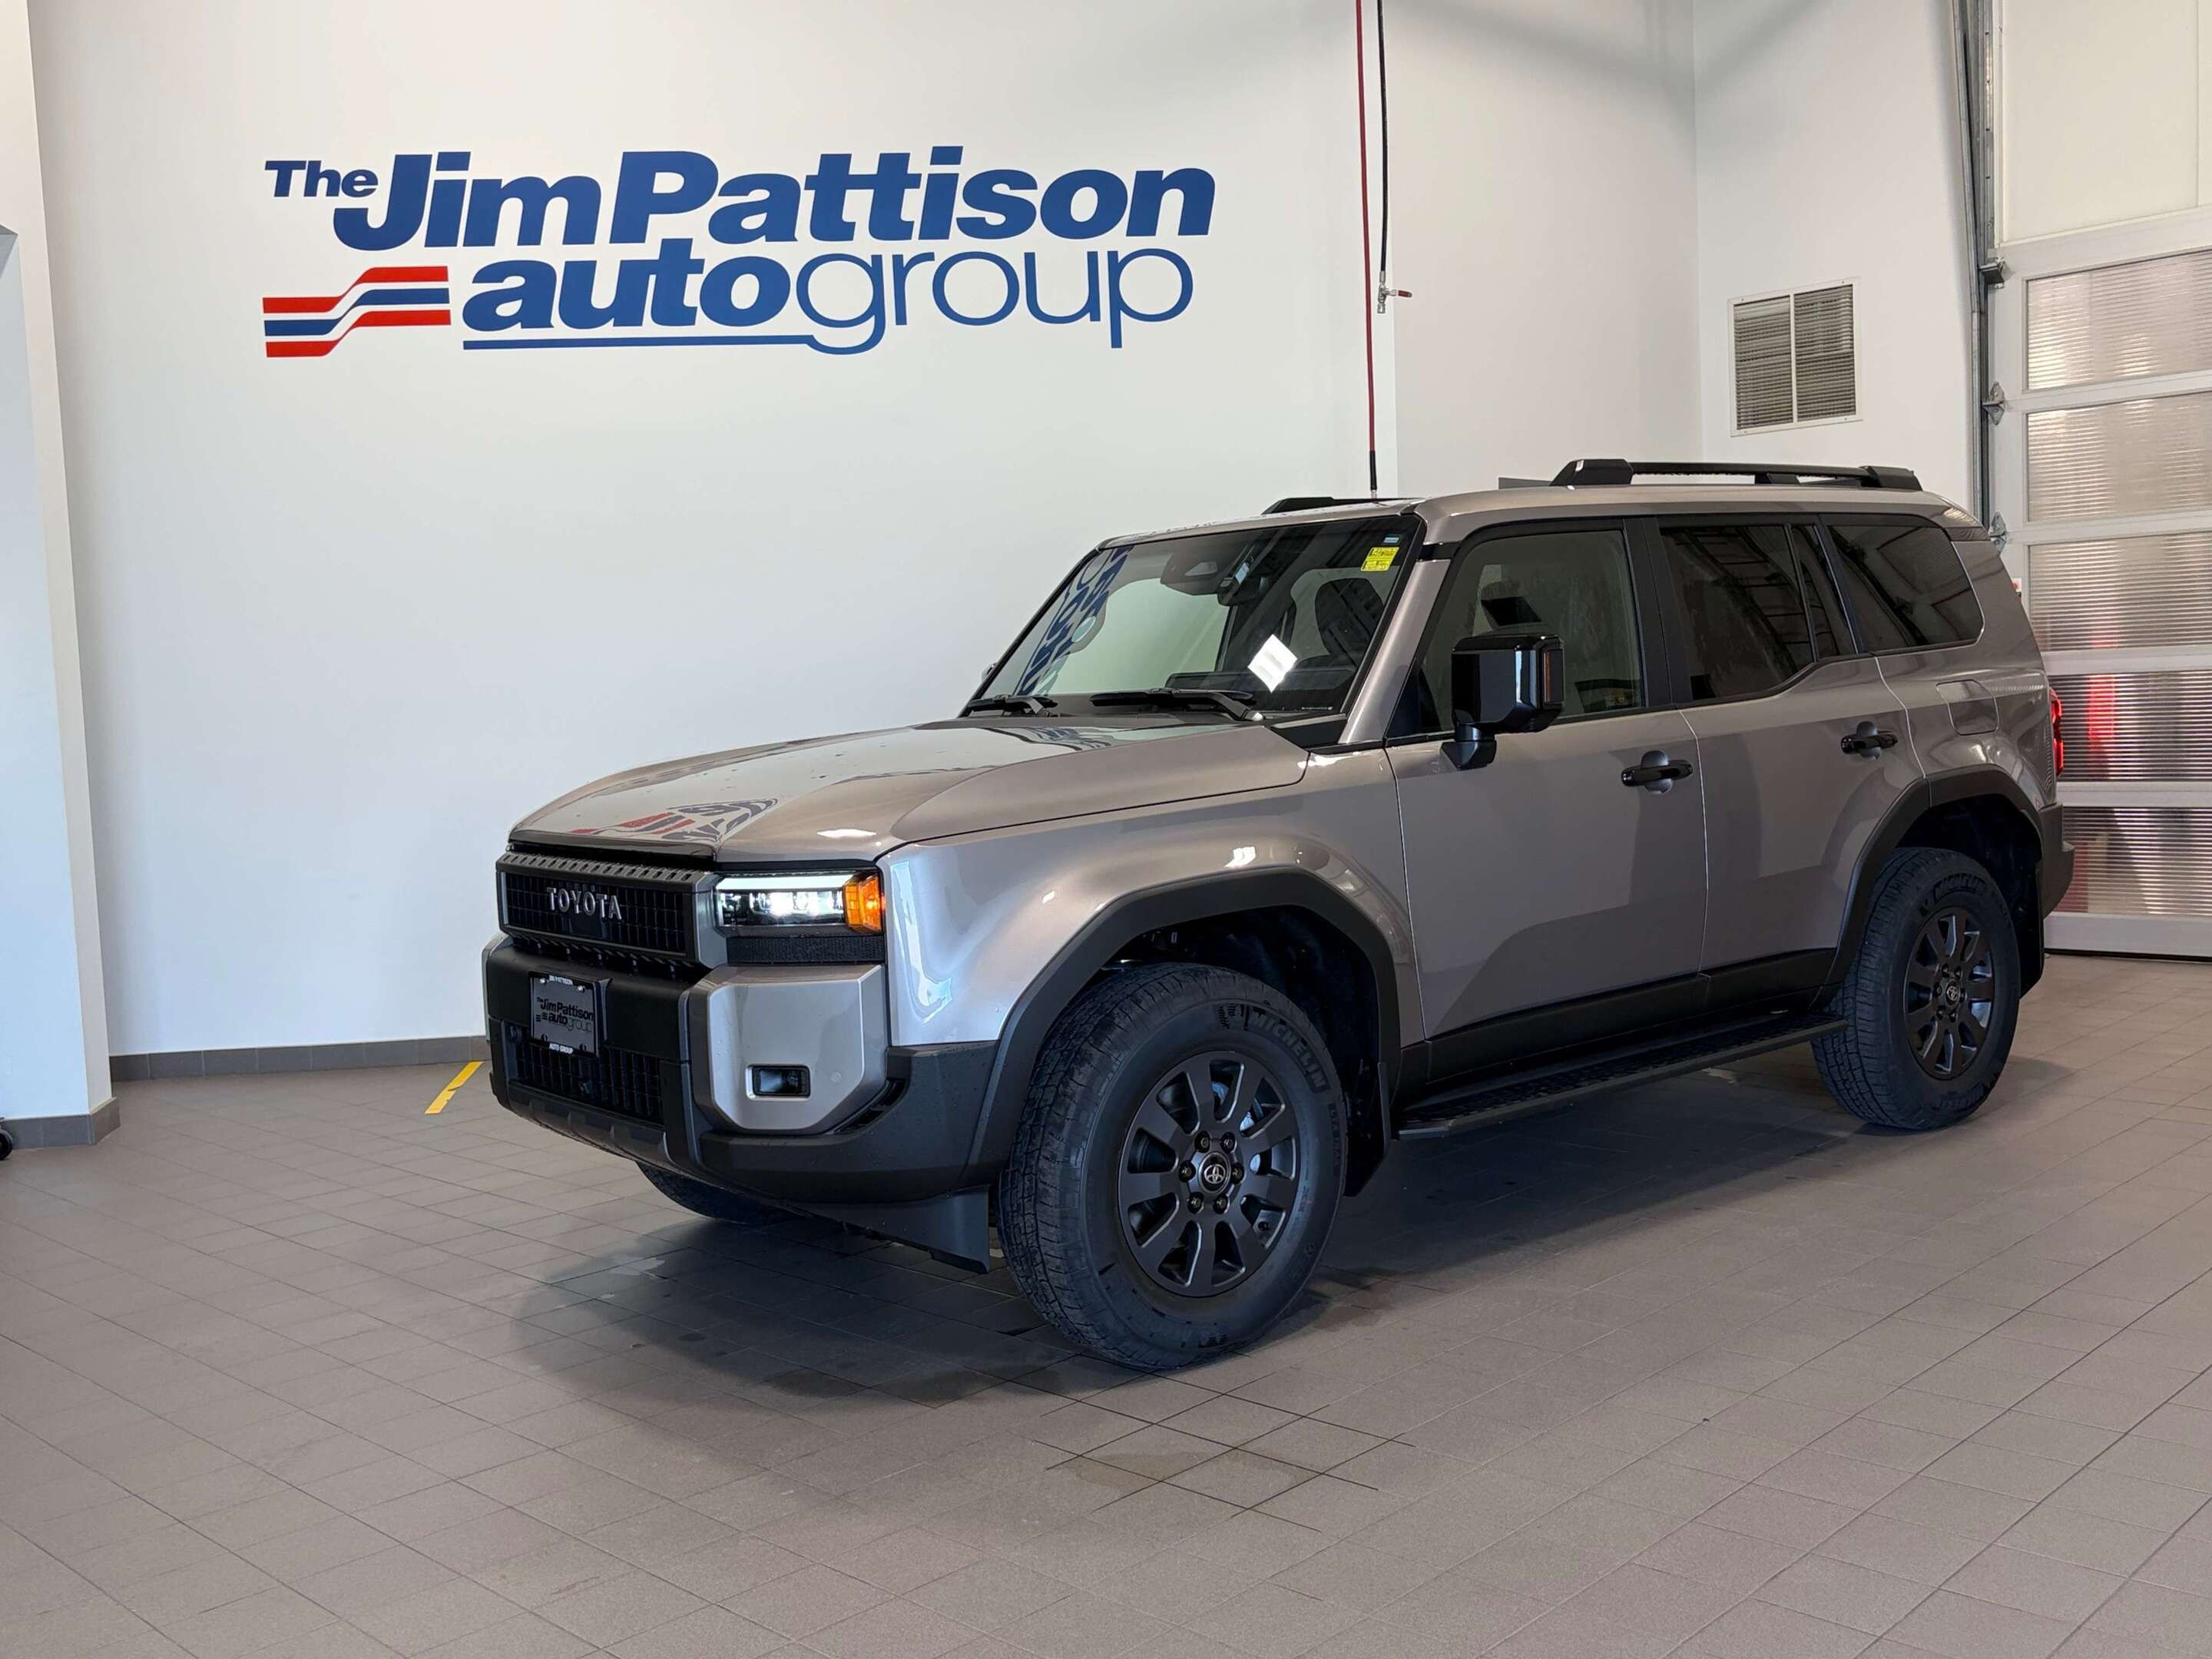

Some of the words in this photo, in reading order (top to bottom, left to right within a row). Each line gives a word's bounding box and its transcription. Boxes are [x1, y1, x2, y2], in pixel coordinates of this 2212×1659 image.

[267, 161, 376, 197] The
[546, 886, 622, 920] TOYOTA
[1249, 1011, 1327, 1088] MICHELIN
